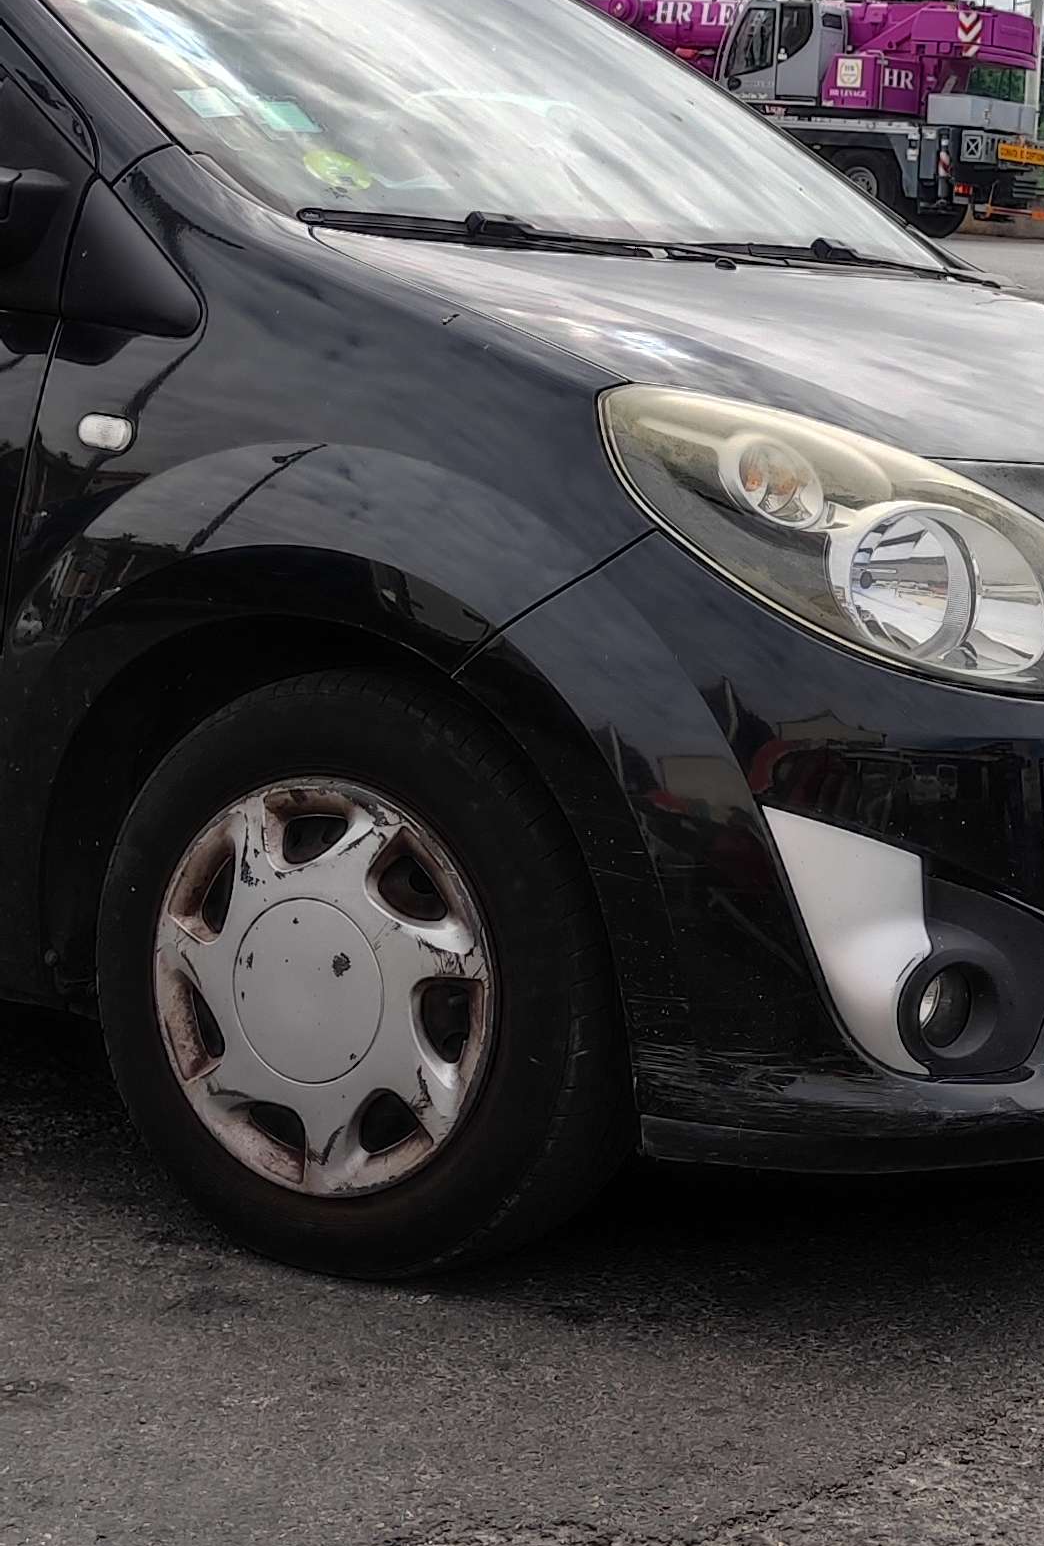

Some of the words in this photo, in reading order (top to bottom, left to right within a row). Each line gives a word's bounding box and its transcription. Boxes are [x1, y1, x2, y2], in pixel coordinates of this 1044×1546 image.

[654, 0, 692, 25] HR
[701, 1, 744, 26] LE
[884, 68, 914, 90] HR
